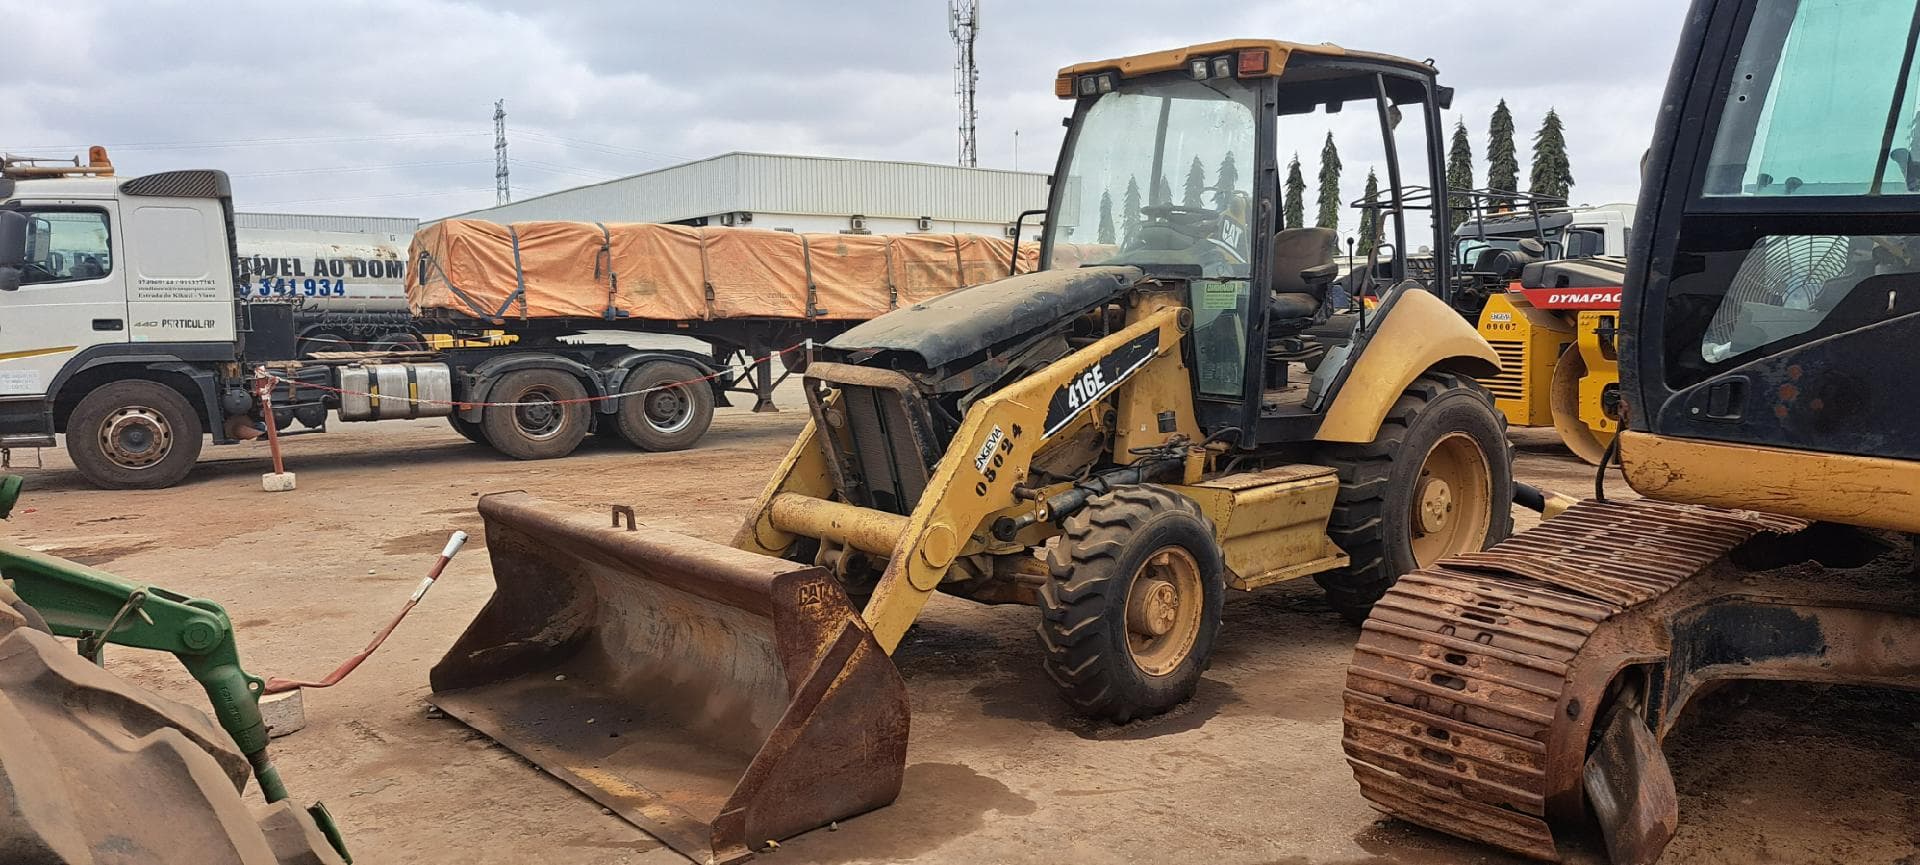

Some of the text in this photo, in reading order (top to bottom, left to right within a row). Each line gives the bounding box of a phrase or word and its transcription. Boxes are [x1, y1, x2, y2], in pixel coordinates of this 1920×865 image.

[1222, 219, 1243, 249] CAT
[314, 259, 344, 277] AO
[352, 259, 408, 279] DOM
[259, 278, 297, 297] 341
[304, 279, 345, 296] 934
[1548, 293, 1621, 304] DYNAPAC
[162, 319, 215, 329] PARTICULAR
[1068, 363, 1106, 409] 416E
[974, 428, 1002, 471] ENGEVIA
[975, 423, 1022, 497] 05024
